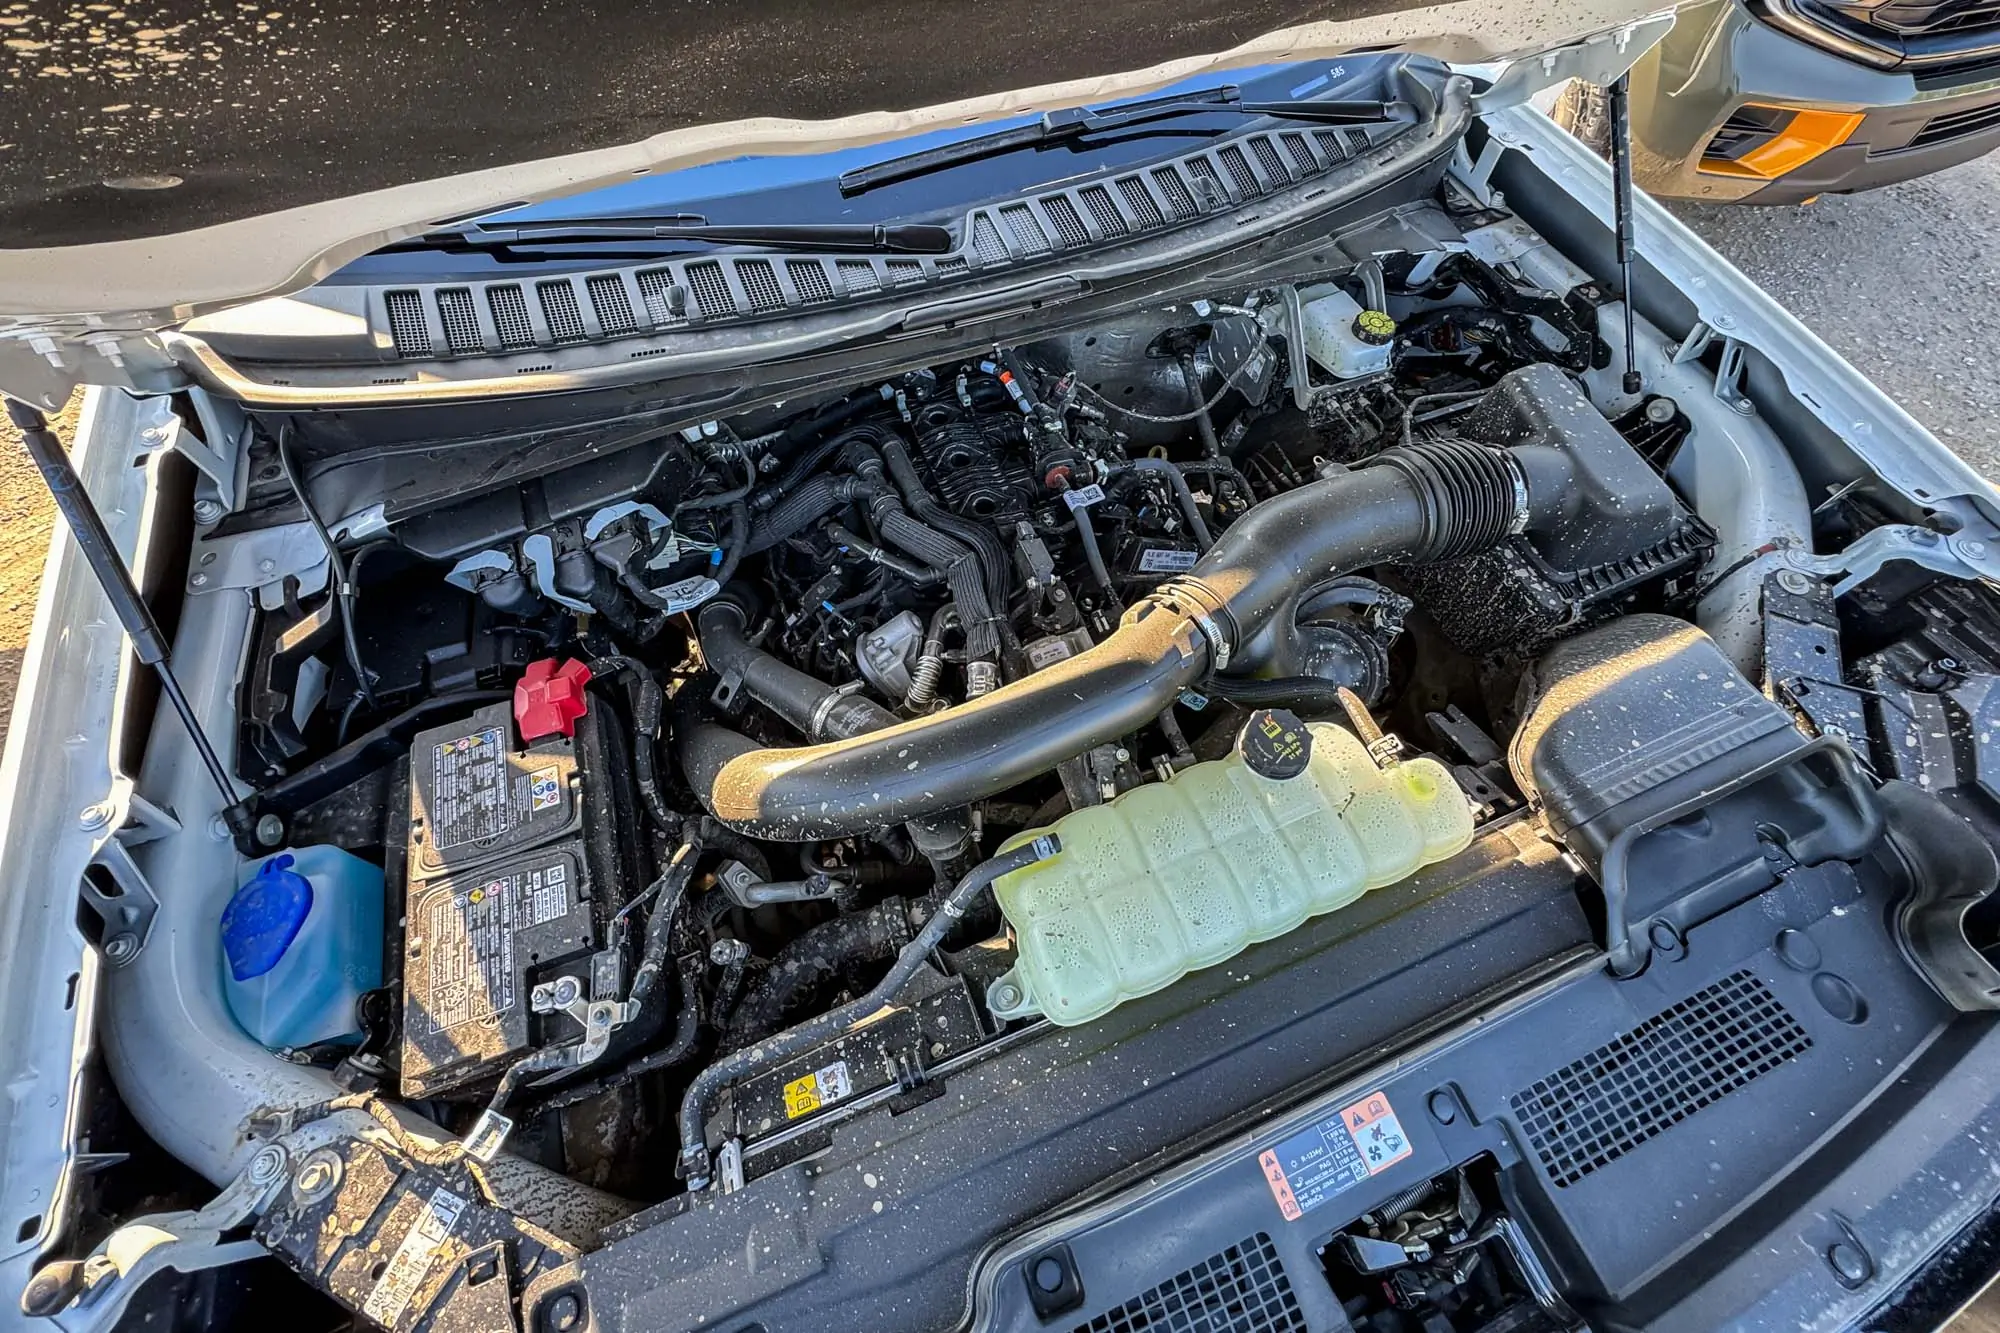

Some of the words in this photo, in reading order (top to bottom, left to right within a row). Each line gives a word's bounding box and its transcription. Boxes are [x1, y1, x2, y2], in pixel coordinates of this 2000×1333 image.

[1330, 66, 1345, 78] 585
[1319, 1160, 1332, 1171] PAG
[1300, 1194, 1324, 1210] FoMoCo
